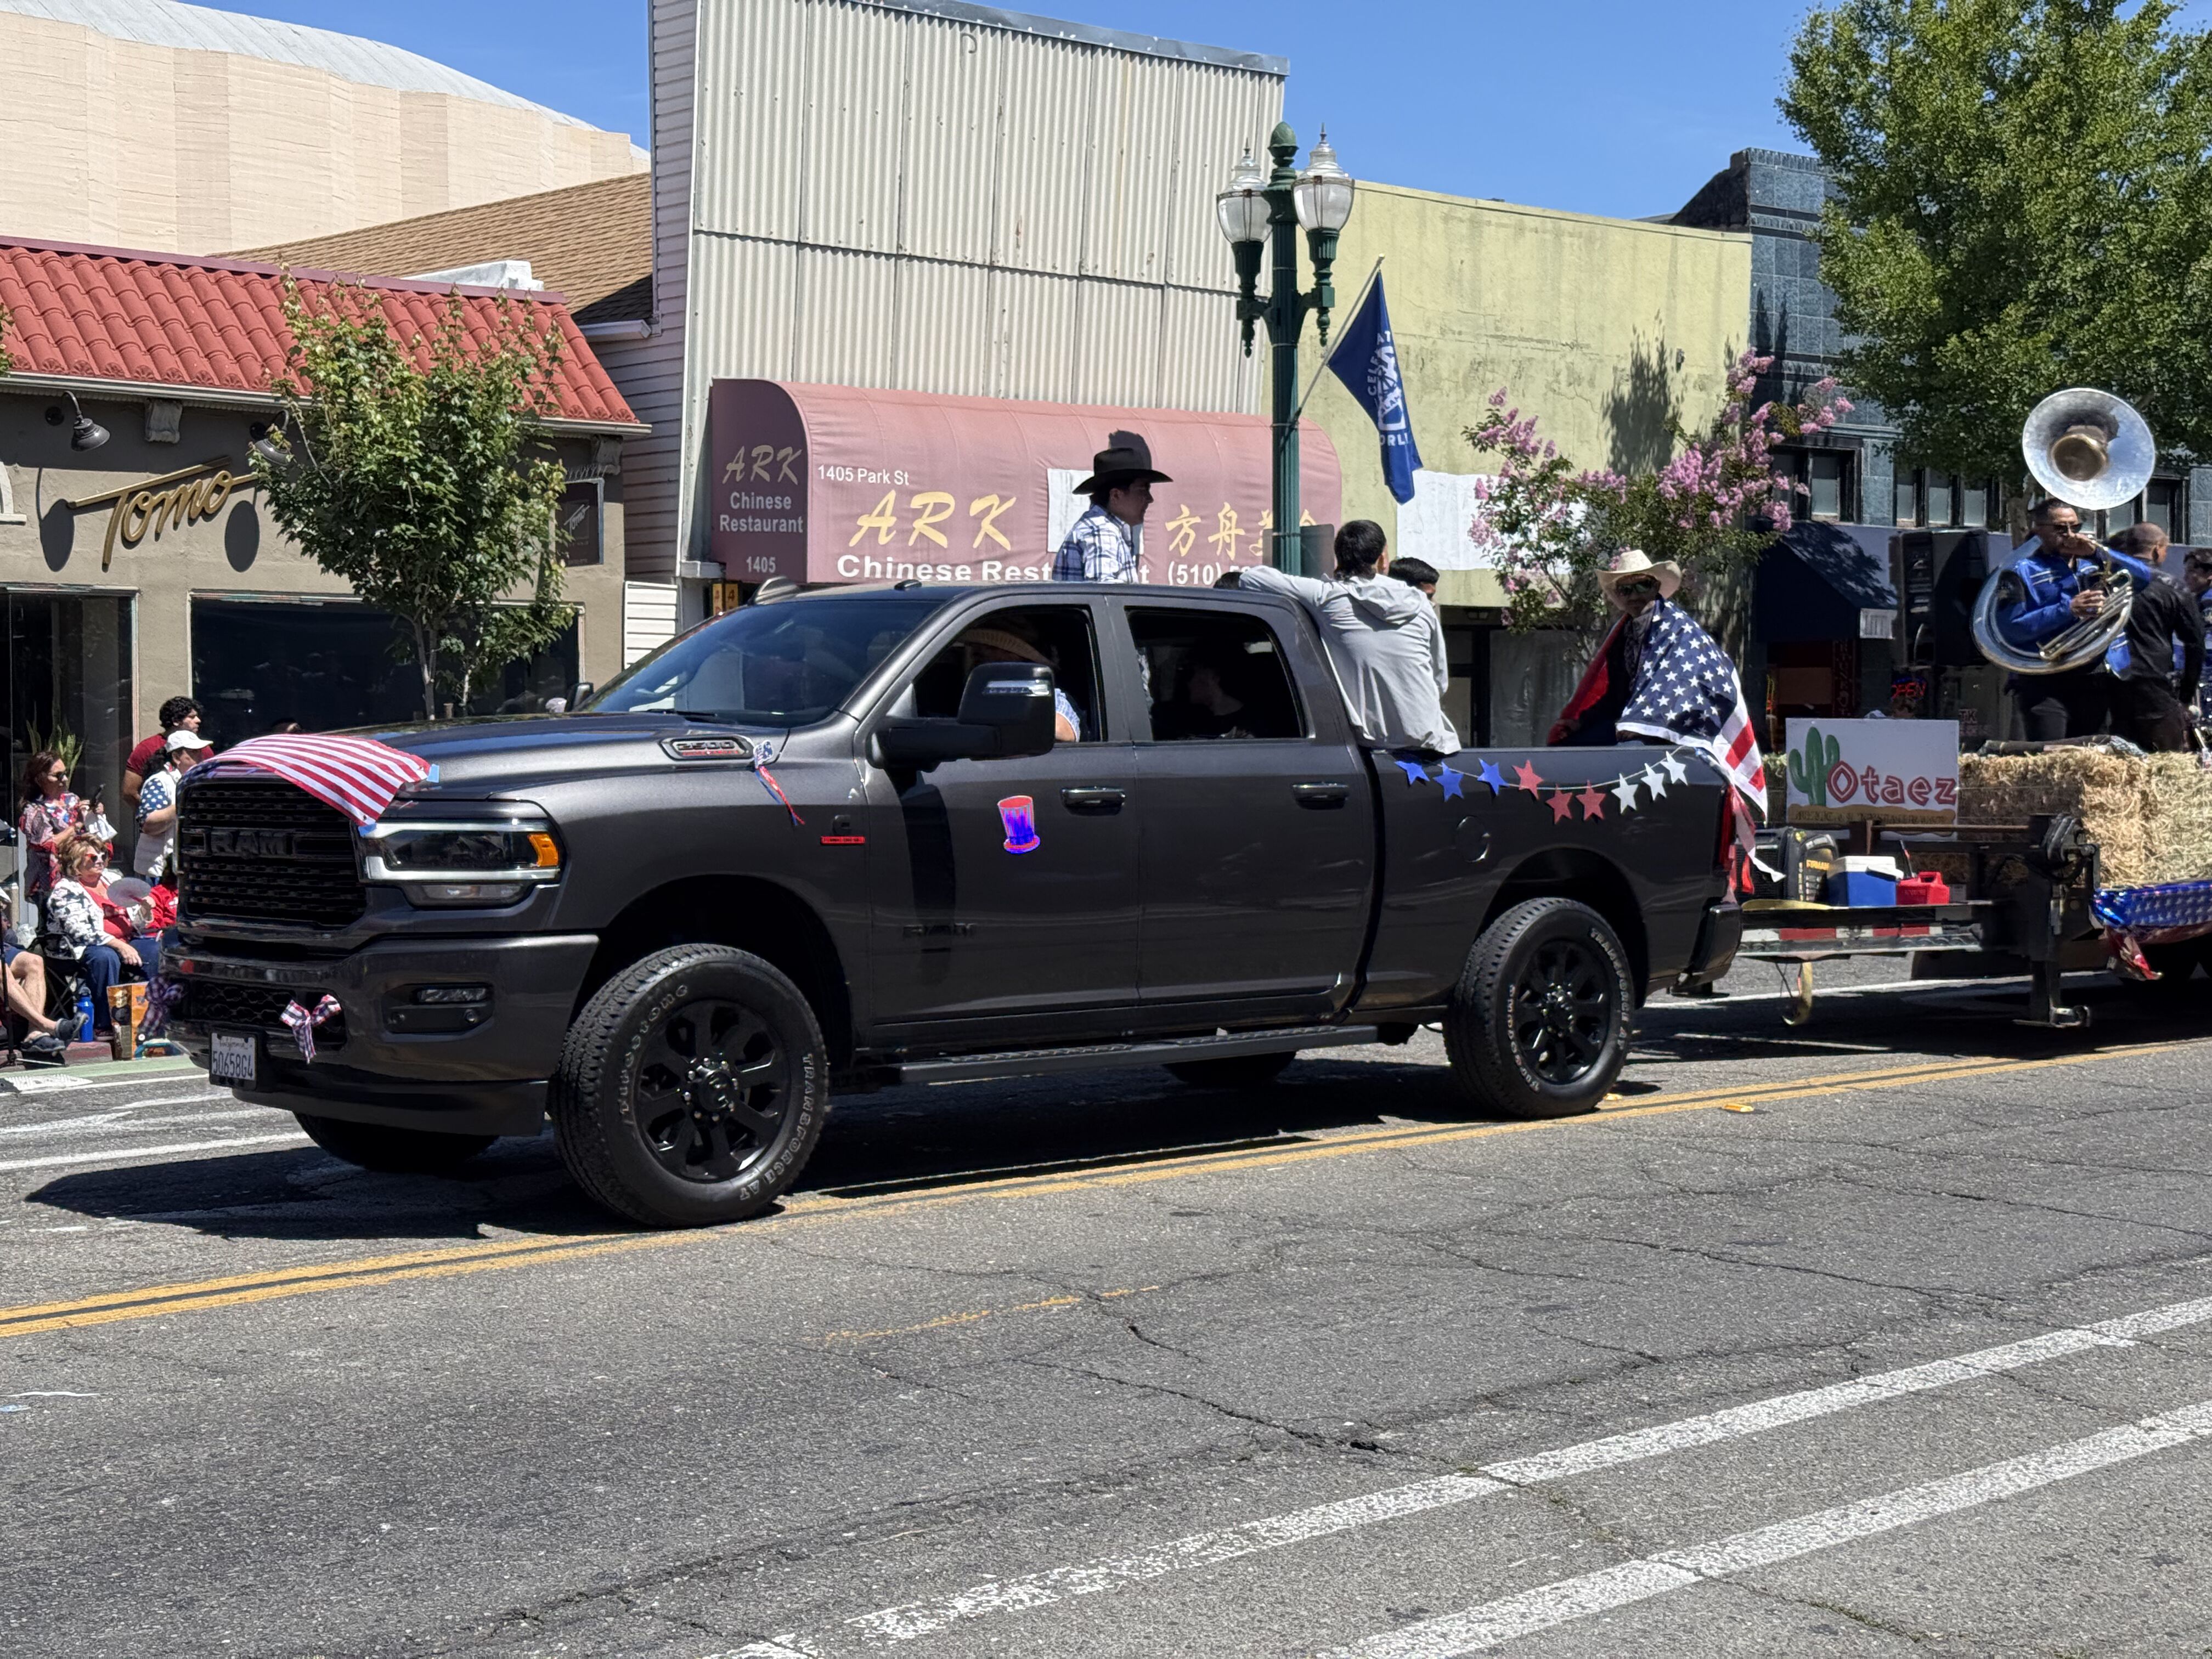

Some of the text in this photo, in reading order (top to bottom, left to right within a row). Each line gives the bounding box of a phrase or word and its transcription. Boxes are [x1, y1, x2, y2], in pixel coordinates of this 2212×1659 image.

[722, 445, 803, 485] ARK
[818, 465, 910, 486] 1405 Park St
[67, 456, 258, 565] Tomo
[730, 492, 792, 509] Chinese
[720, 515, 803, 533] Restaurant
[849, 489, 1017, 551] ARK
[746, 556, 777, 573] 1405
[837, 555, 972, 580] Chinese
[1827, 760, 1957, 806] Otaez
[212, 1051, 253, 1079] 50658G4
